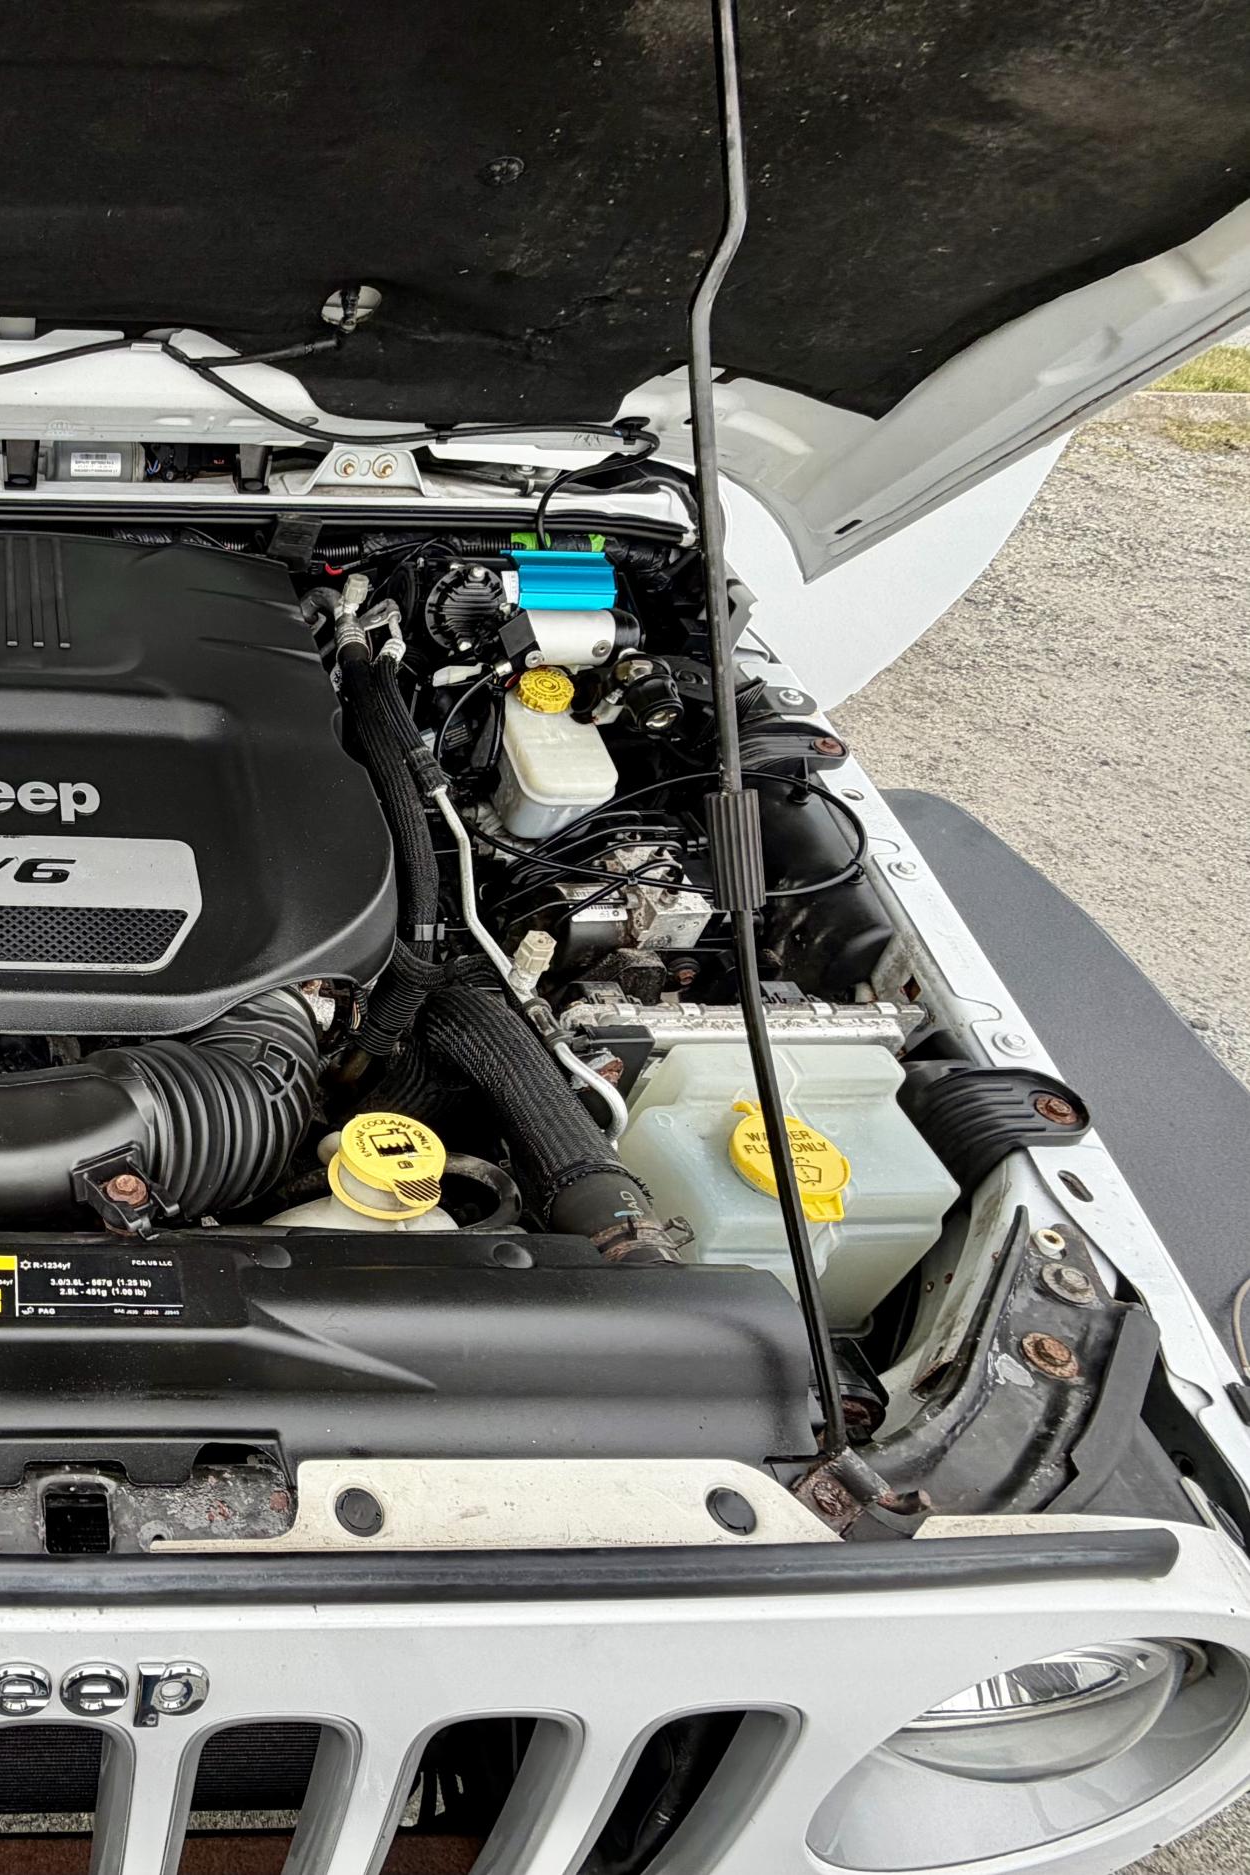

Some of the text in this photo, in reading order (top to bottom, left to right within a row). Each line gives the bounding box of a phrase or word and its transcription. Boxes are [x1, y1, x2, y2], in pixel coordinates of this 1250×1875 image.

[355, 1119, 432, 1158] ENGINE COOLANT ONLY
[790, 1142, 828, 1153] ONLY
[32, 1261, 71, 1271] R-1234yf
[131, 1259, 147, 1267] FCA
[147, 1259, 158, 1267] US
[139, 1279, 152, 1289] lb)
[134, 1288, 147, 1298] lb)
[38, 1307, 56, 1315] PAG
